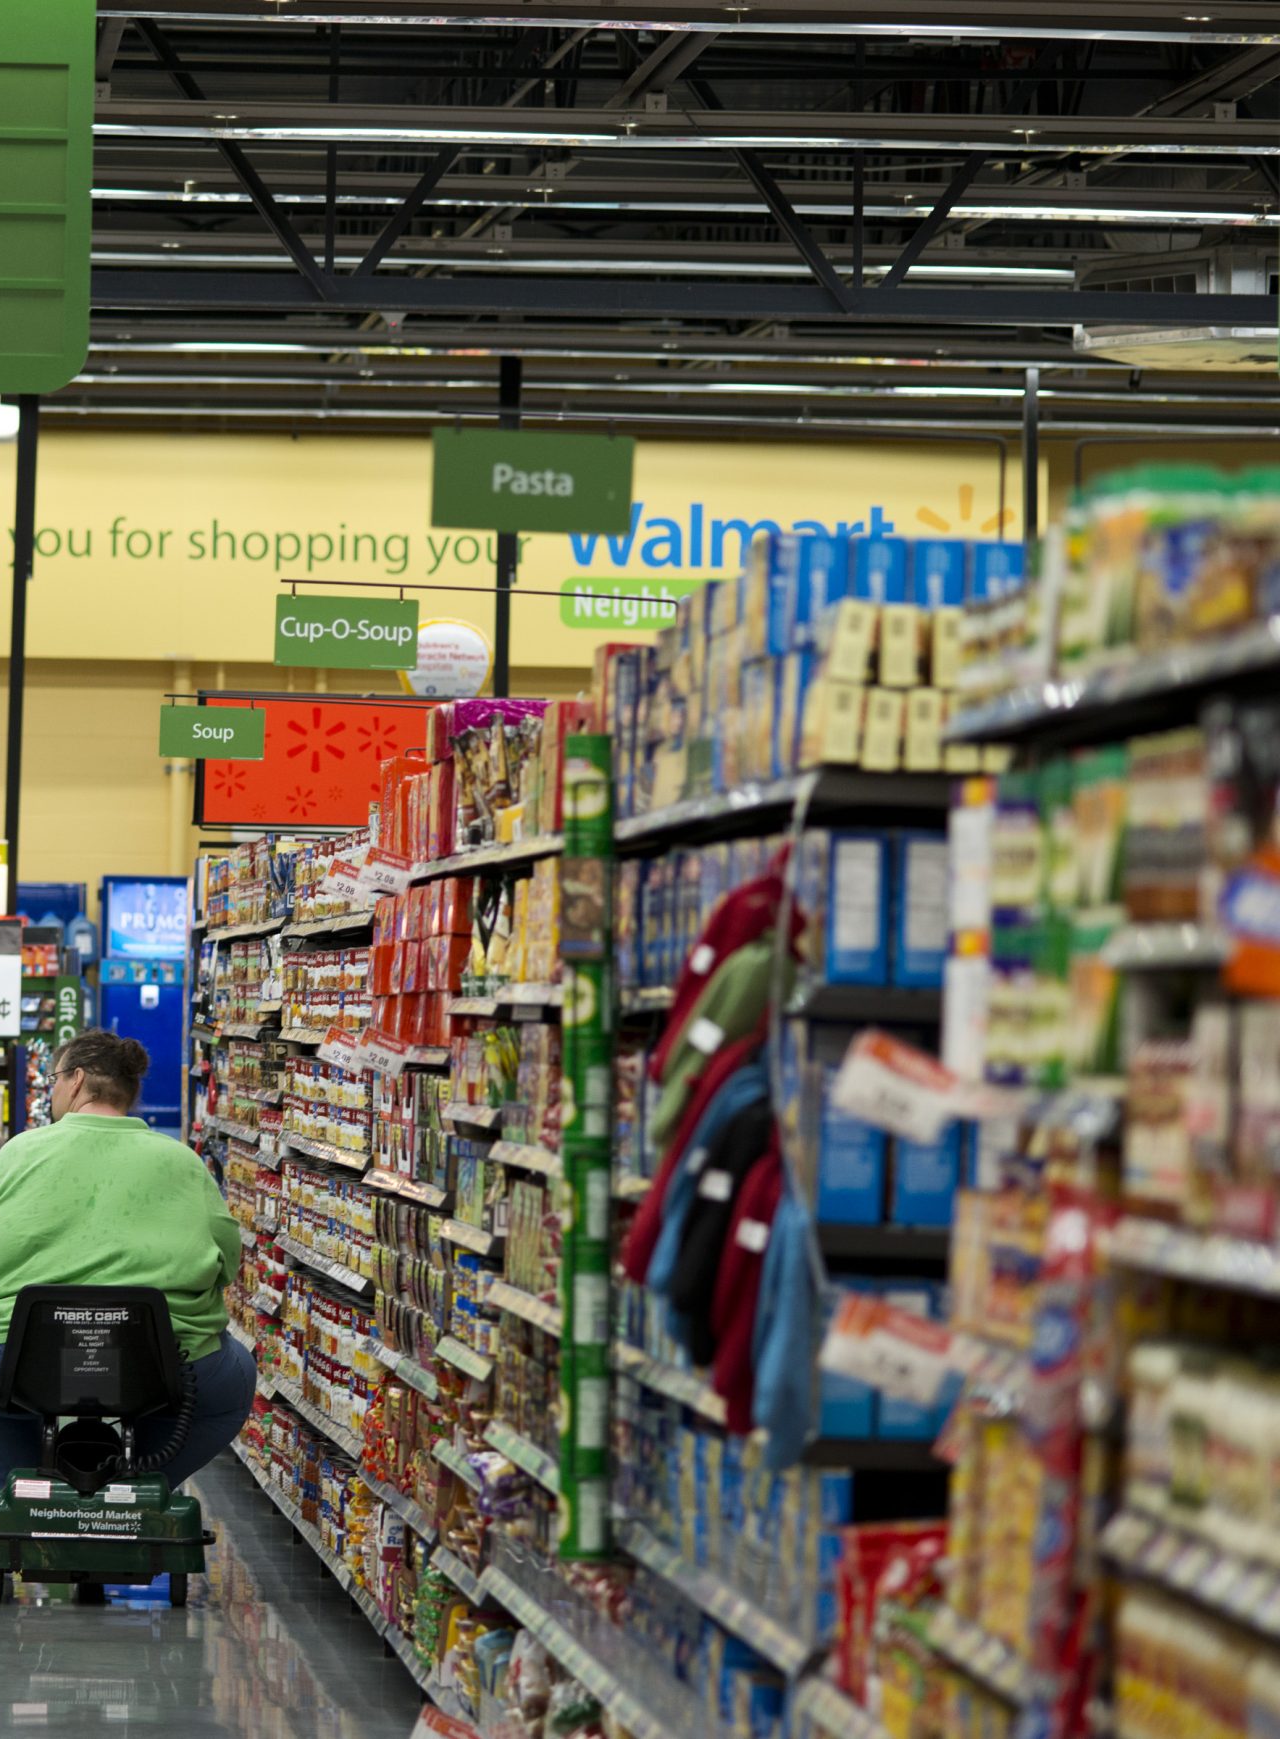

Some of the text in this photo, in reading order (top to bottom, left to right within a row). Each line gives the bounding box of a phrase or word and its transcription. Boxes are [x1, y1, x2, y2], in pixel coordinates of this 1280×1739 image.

[492, 463, 573, 496] Pasta
[109, 517, 173, 559] for
[188, 519, 409, 574] shopping
[280, 616, 413, 645] Cup-O-Soup
[192, 723, 234, 743] Soup
[121, 911, 187, 931] PRIMO
[59, 986, 78, 1023] Gift
[29, 1508, 142, 1520] Neighborhood Market
[78, 1521, 130, 1532] by Walmart
